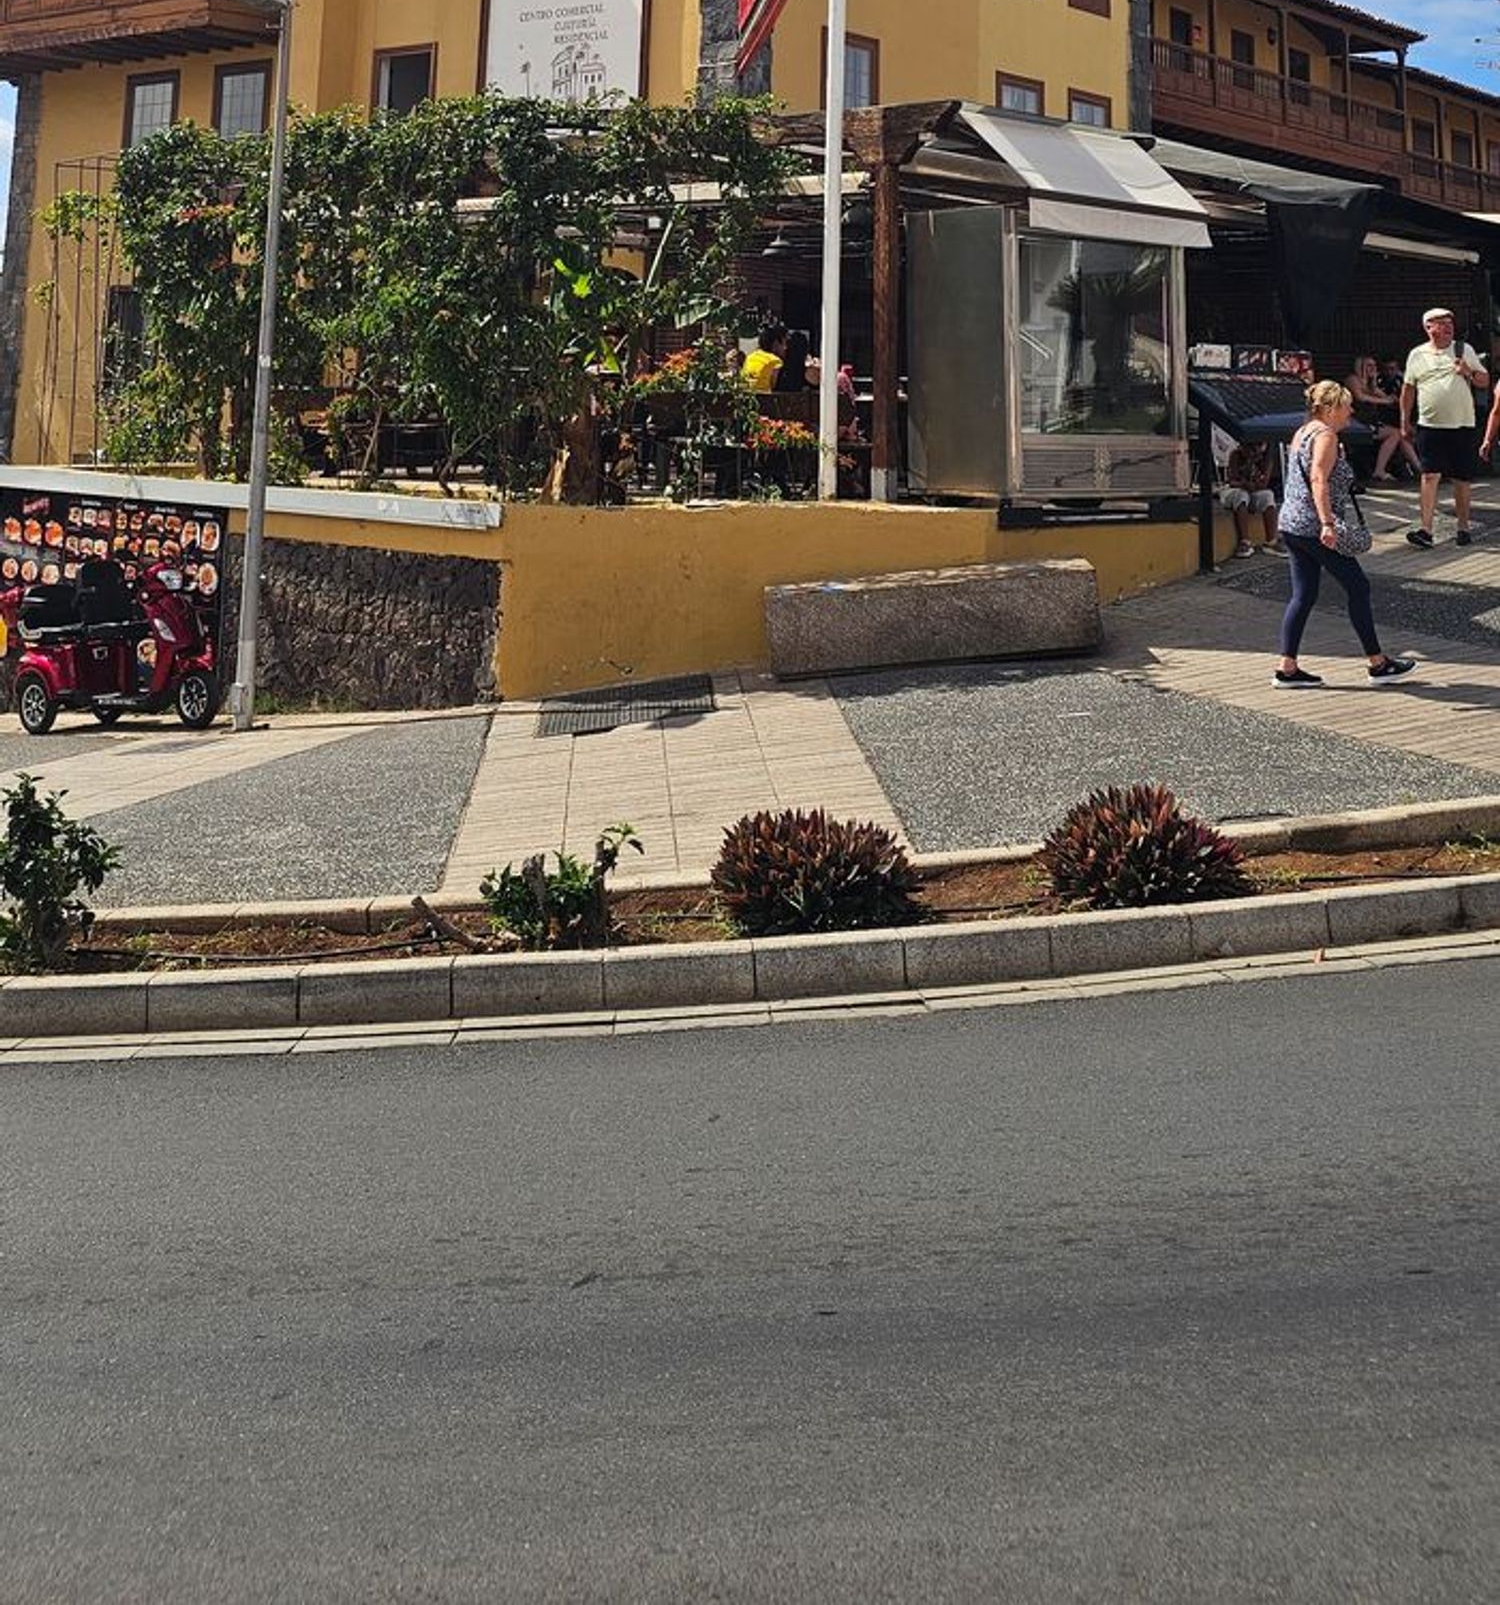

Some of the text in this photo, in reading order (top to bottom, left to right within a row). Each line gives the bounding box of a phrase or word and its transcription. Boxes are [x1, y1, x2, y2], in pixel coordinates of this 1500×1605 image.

[519, 3, 604, 23] CENTRO COMERCIAL
[554, 30, 609, 44] RESIDENCIAL
